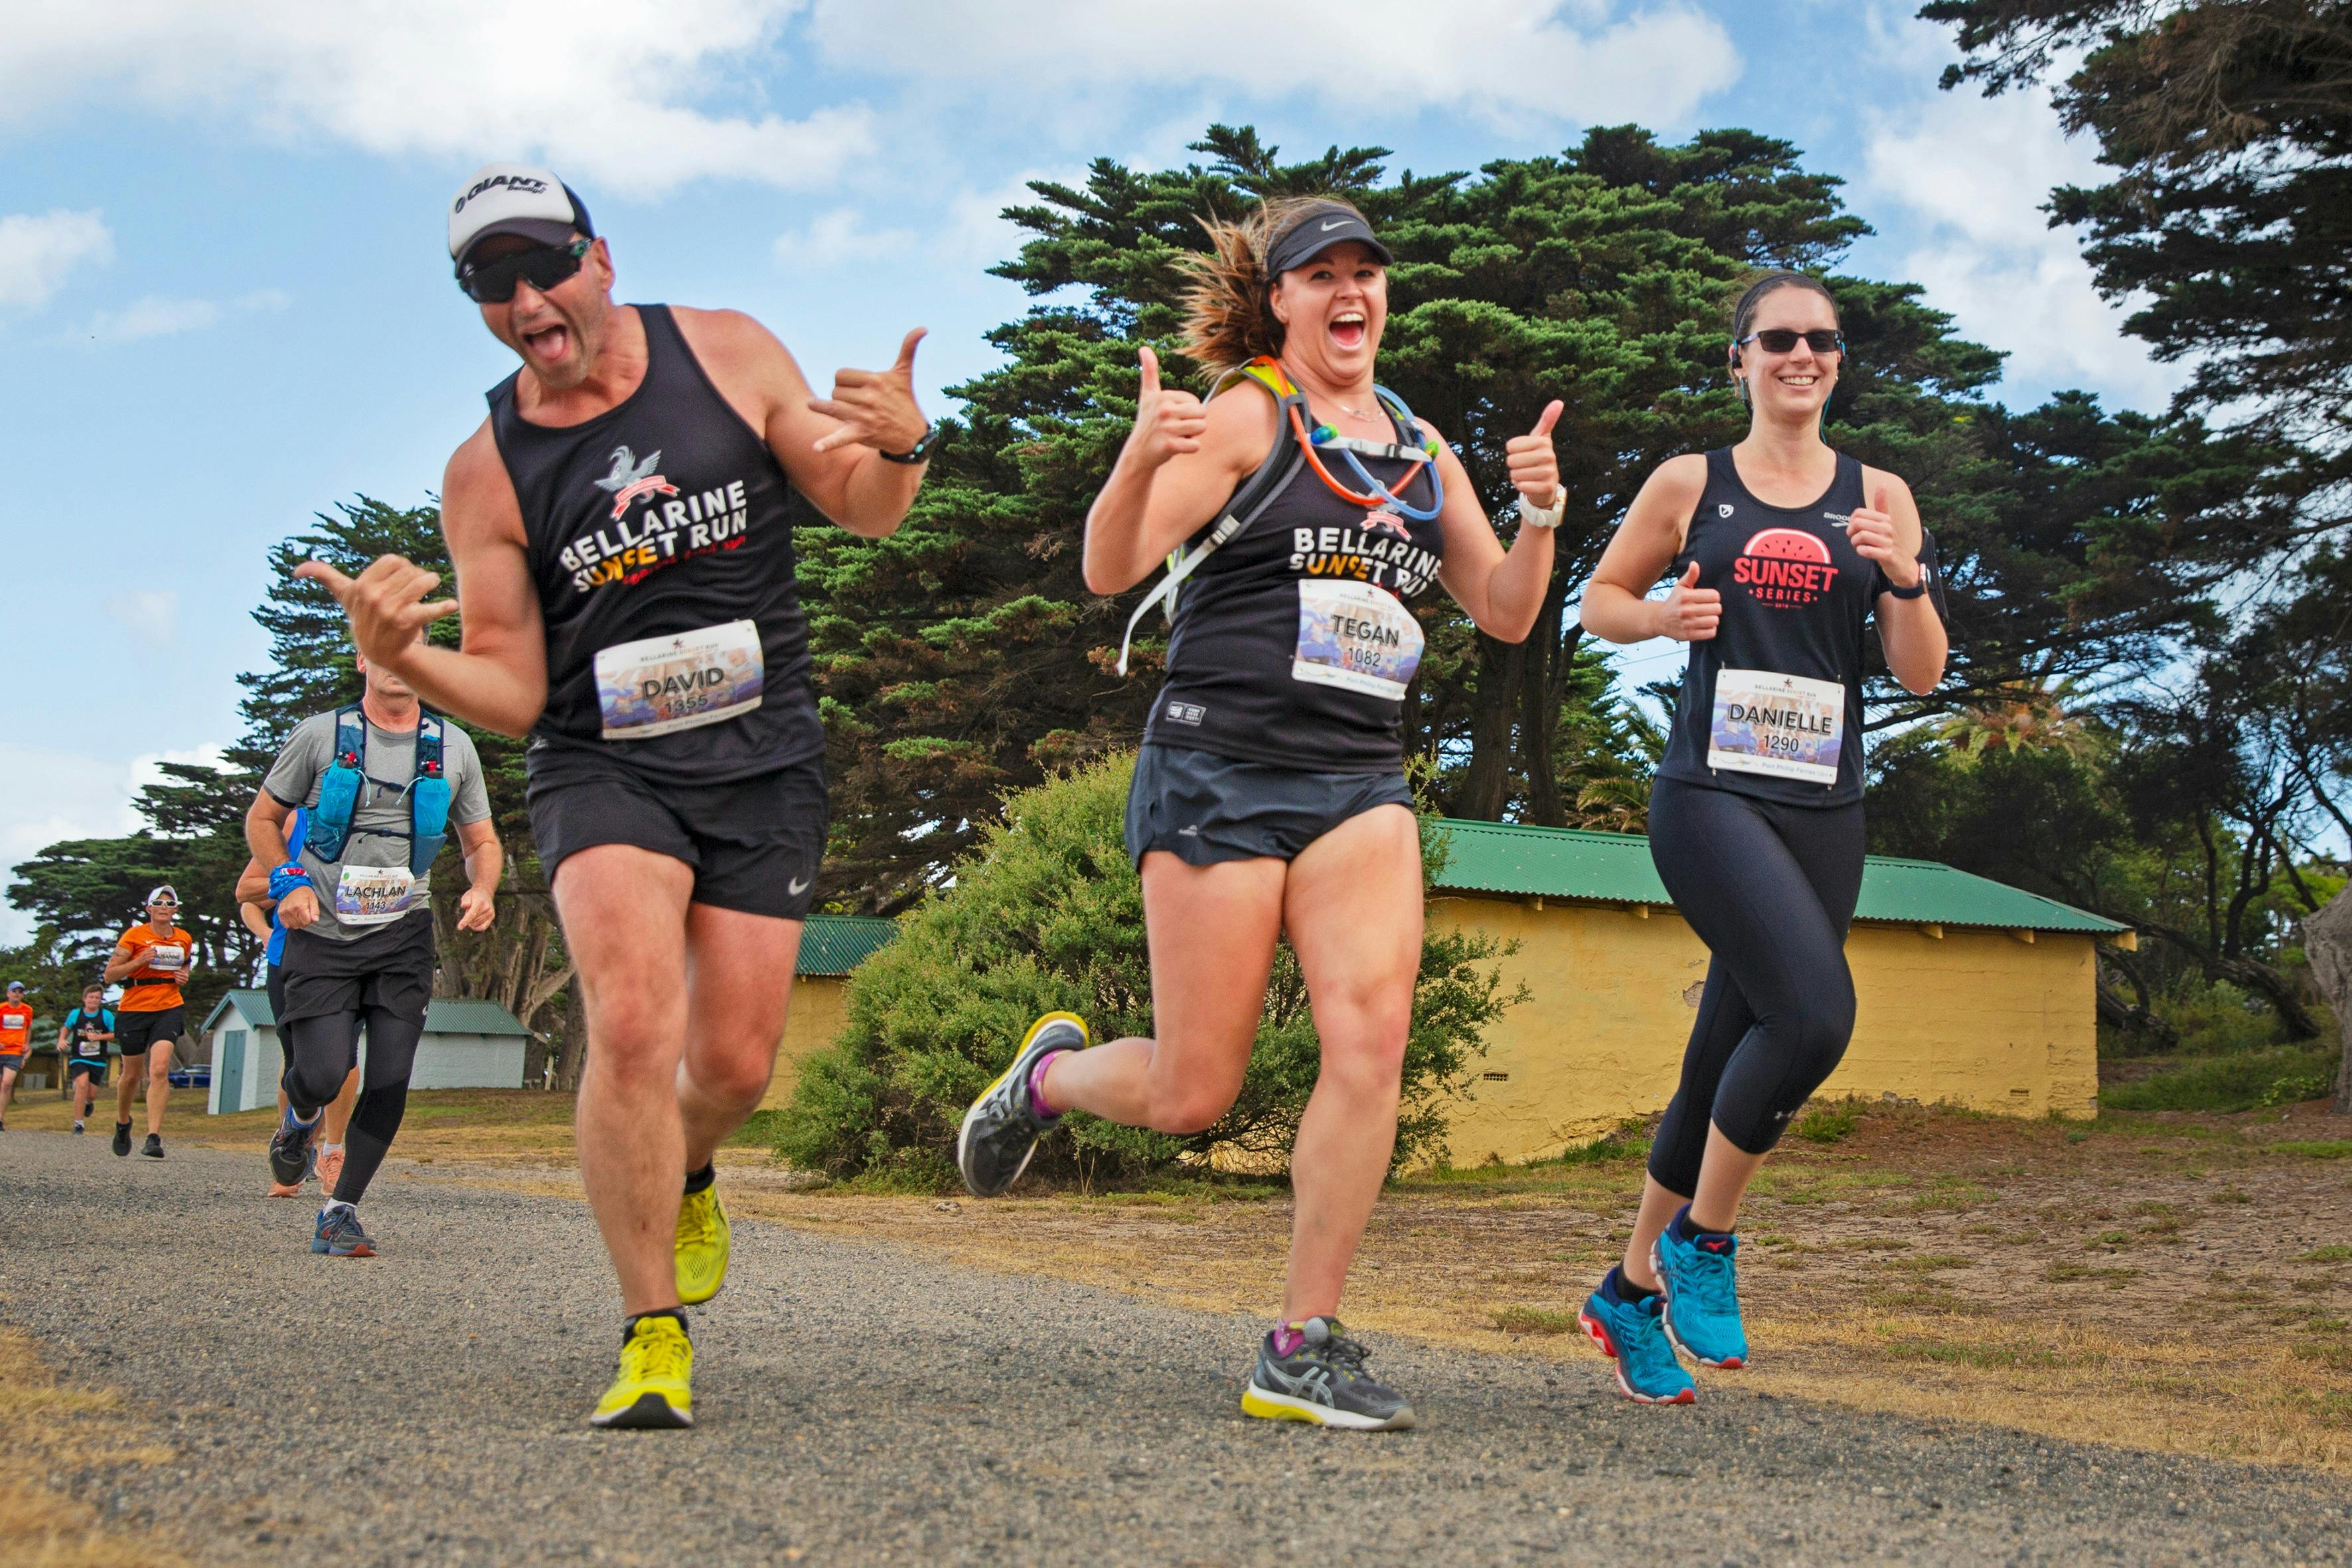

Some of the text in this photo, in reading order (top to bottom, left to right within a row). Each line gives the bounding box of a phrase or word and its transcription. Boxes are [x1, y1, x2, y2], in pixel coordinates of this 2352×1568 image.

[467, 175, 548, 201] GIANT
[507, 185, 546, 195] Bendigo
[559, 480, 747, 572] BELLARINE
[1824, 512, 1850, 521] BROO
[573, 532, 678, 592] SUNSET
[690, 509, 747, 550] RUN
[1294, 527, 1442, 582] BELLARINE
[1289, 553, 1388, 584] SUNSET
[1733, 557, 1838, 592] SUNSET
[1756, 588, 1811, 603] SERIES
[1331, 614, 1399, 648] TEGAN
[1348, 647, 1381, 668] 1082
[642, 667, 724, 698] DAVID
[665, 696, 708, 713] 1355
[1728, 703, 1832, 736] DANIELLE
[1764, 734, 1799, 751] 1290
[345, 886, 406, 898] LACHLAN
